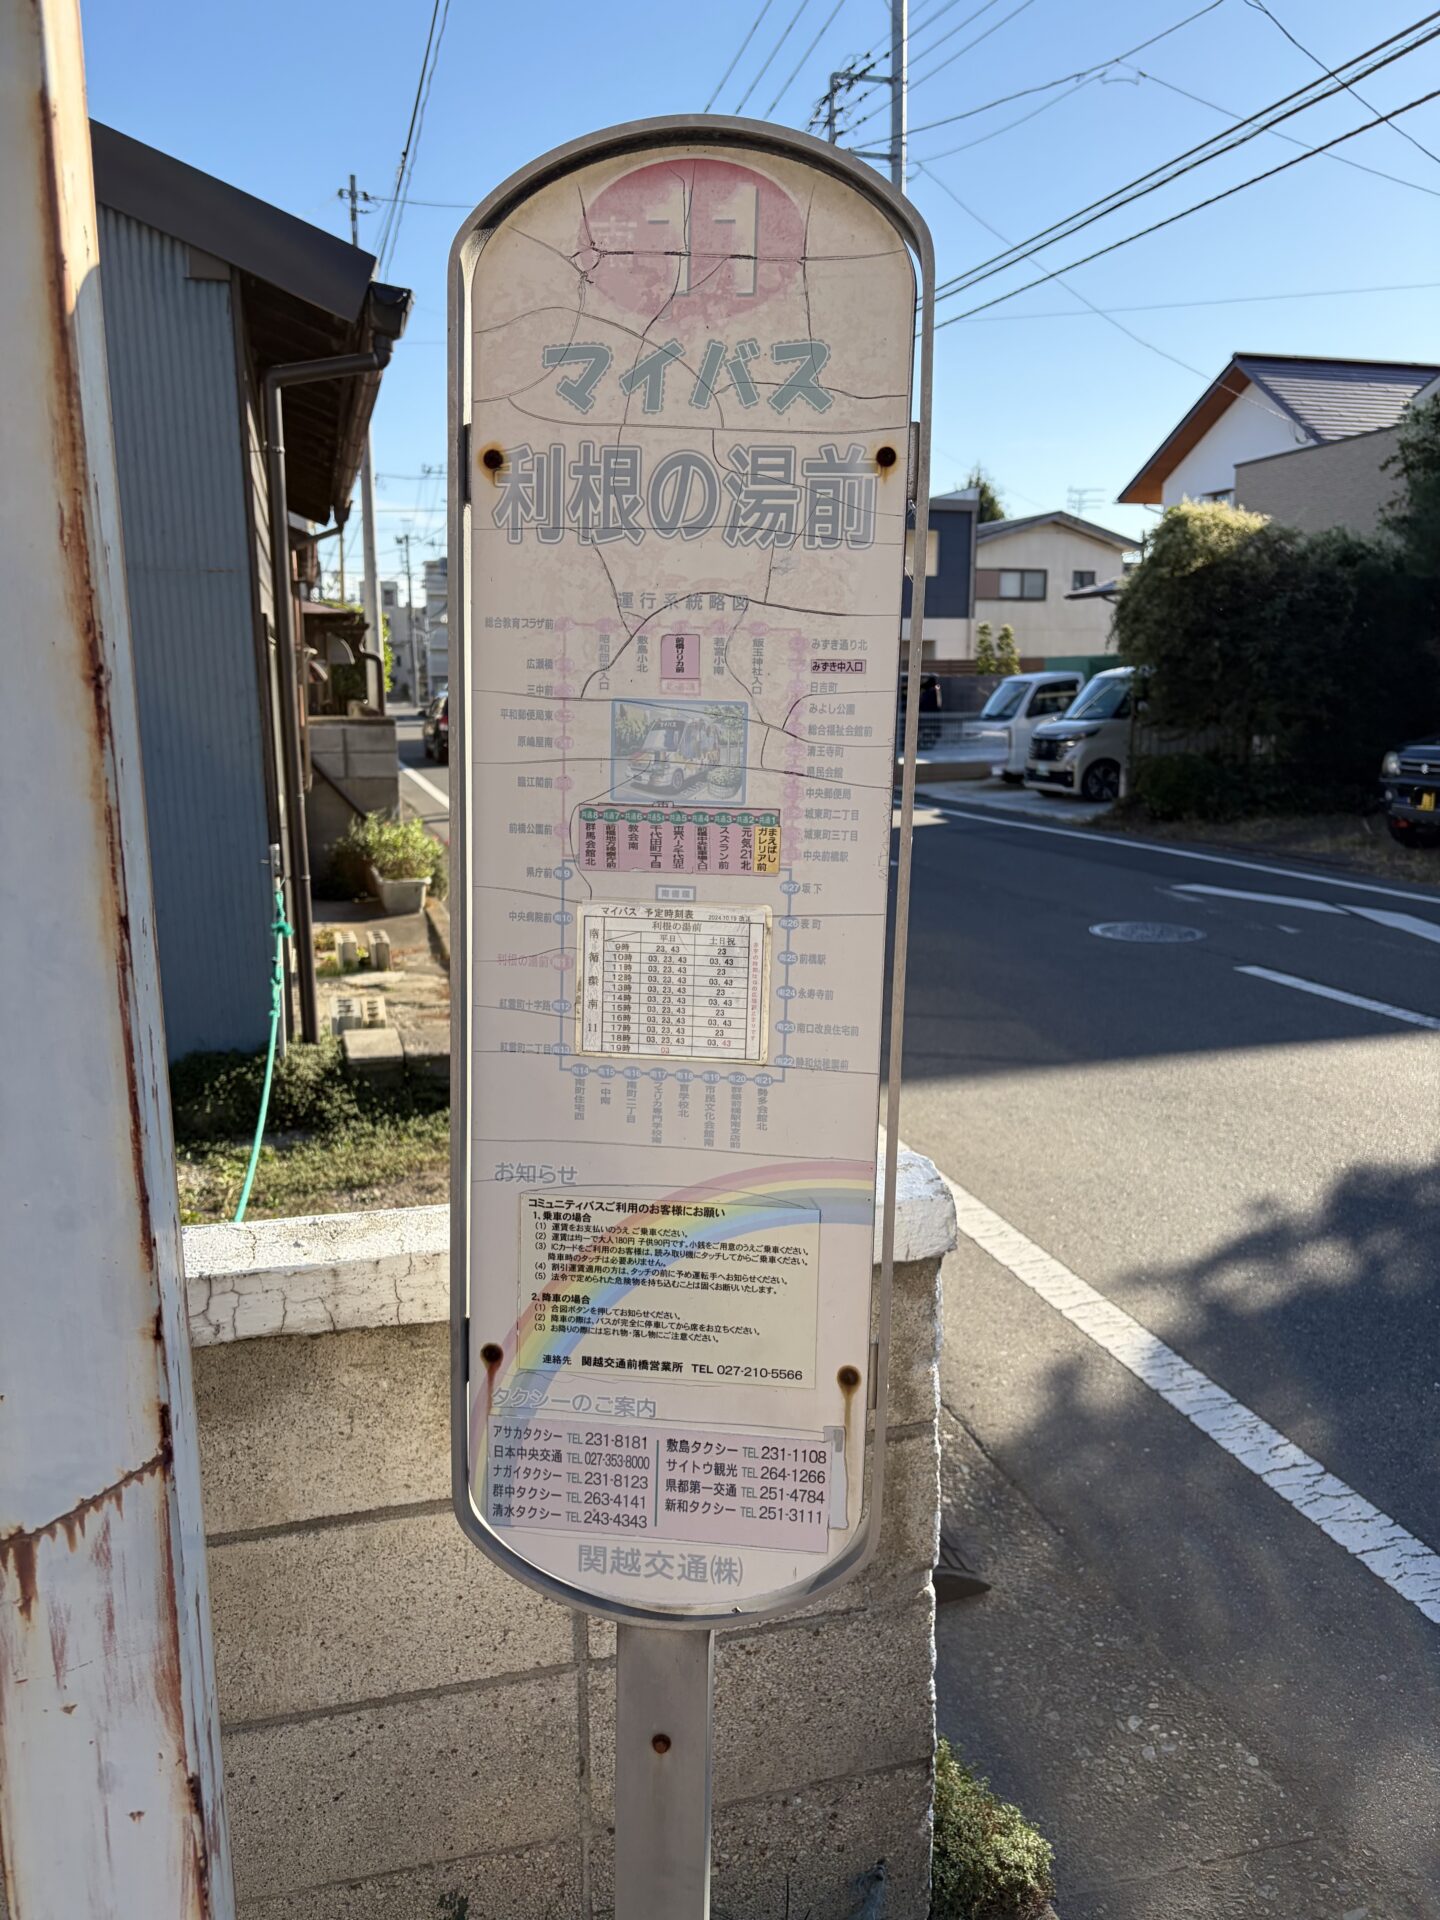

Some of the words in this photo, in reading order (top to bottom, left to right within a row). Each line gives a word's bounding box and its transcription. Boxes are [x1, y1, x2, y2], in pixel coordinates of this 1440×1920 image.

[643, 182, 760, 297] 11
[542, 339, 834, 413] マイバス
[492, 442, 881, 550] 利根の湯前
[618, 591, 750, 611] 運行系統略図
[811, 638, 868, 652] みずき通り北
[811, 661, 863, 673] みずき中入口
[527, 684, 553, 696] 三中前
[810, 681, 838, 694] 日吉町
[808, 703, 856, 716] みよし公園
[804, 808, 860, 821] 城東町二丁目
[585, 822, 597, 867] 群馬会館北
[627, 824, 639, 851] 教会南
[767, 828, 778, 863] まえばし
[803, 828, 859, 842] 城東町三丁目
[718, 826, 731, 871] スズラン前
[740, 827, 753, 871] 元気21北
[757, 828, 768, 872] ガレリア前
[601, 906, 637, 918] マイバス
[644, 908, 694, 920] 予定時刻表
[652, 921, 702, 933] 利根の湯前
[660, 935, 676, 943] 平日
[710, 937, 736, 946] 土日祝
[611, 1034, 630, 1042] 18時
[612, 1024, 631, 1032] 17時
[611, 1044, 630, 1052] 19時
[494, 1162, 578, 1185] お知らせ
[528, 1198, 726, 1218] コミュニティバスご利用のお客様にお願い
[542, 1354, 572, 1365] 連絡先
[582, 1355, 683, 1374] 関越交通前橋営業所
[691, 1363, 713, 1374] TEL
[717, 1365, 803, 1381] 027-210-5566
[492, 1387, 657, 1418] タクシーのご案内
[493, 1425, 563, 1442] アサカタクシー
[566, 1433, 583, 1445] TEL
[585, 1432, 648, 1450] 231-8181
[493, 1445, 563, 1463] 日本中央交通
[566, 1452, 583, 1464] TEL
[584, 1452, 650, 1470] 027-353-8000
[666, 1438, 738, 1456] 敷島タクシー
[742, 1446, 759, 1459] TEL
[761, 1446, 827, 1464] 231-1108
[493, 1465, 563, 1481] ナガイタクシー
[566, 1472, 583, 1485] TEL
[584, 1471, 649, 1490] 231-8123
[666, 1459, 738, 1478] サイトウ観光
[742, 1466, 758, 1479] TEL
[760, 1466, 826, 1484] 264-1266
[492, 1484, 562, 1501] 群中タクシー
[566, 1491, 583, 1504] TEL
[584, 1491, 646, 1510] 263-4141
[665, 1479, 737, 1498] 県都第一交通
[741, 1486, 758, 1499] TEL
[759, 1485, 825, 1505] 251-4784
[492, 1503, 562, 1520] 清水タクシー
[566, 1511, 582, 1523] TEL
[583, 1510, 648, 1529] 243-4343
[664, 1498, 736, 1516] 新和タクシー
[741, 1506, 757, 1519] TEL
[759, 1506, 822, 1525] 251-3111
[577, 1544, 744, 1586] 関越交通(株)
